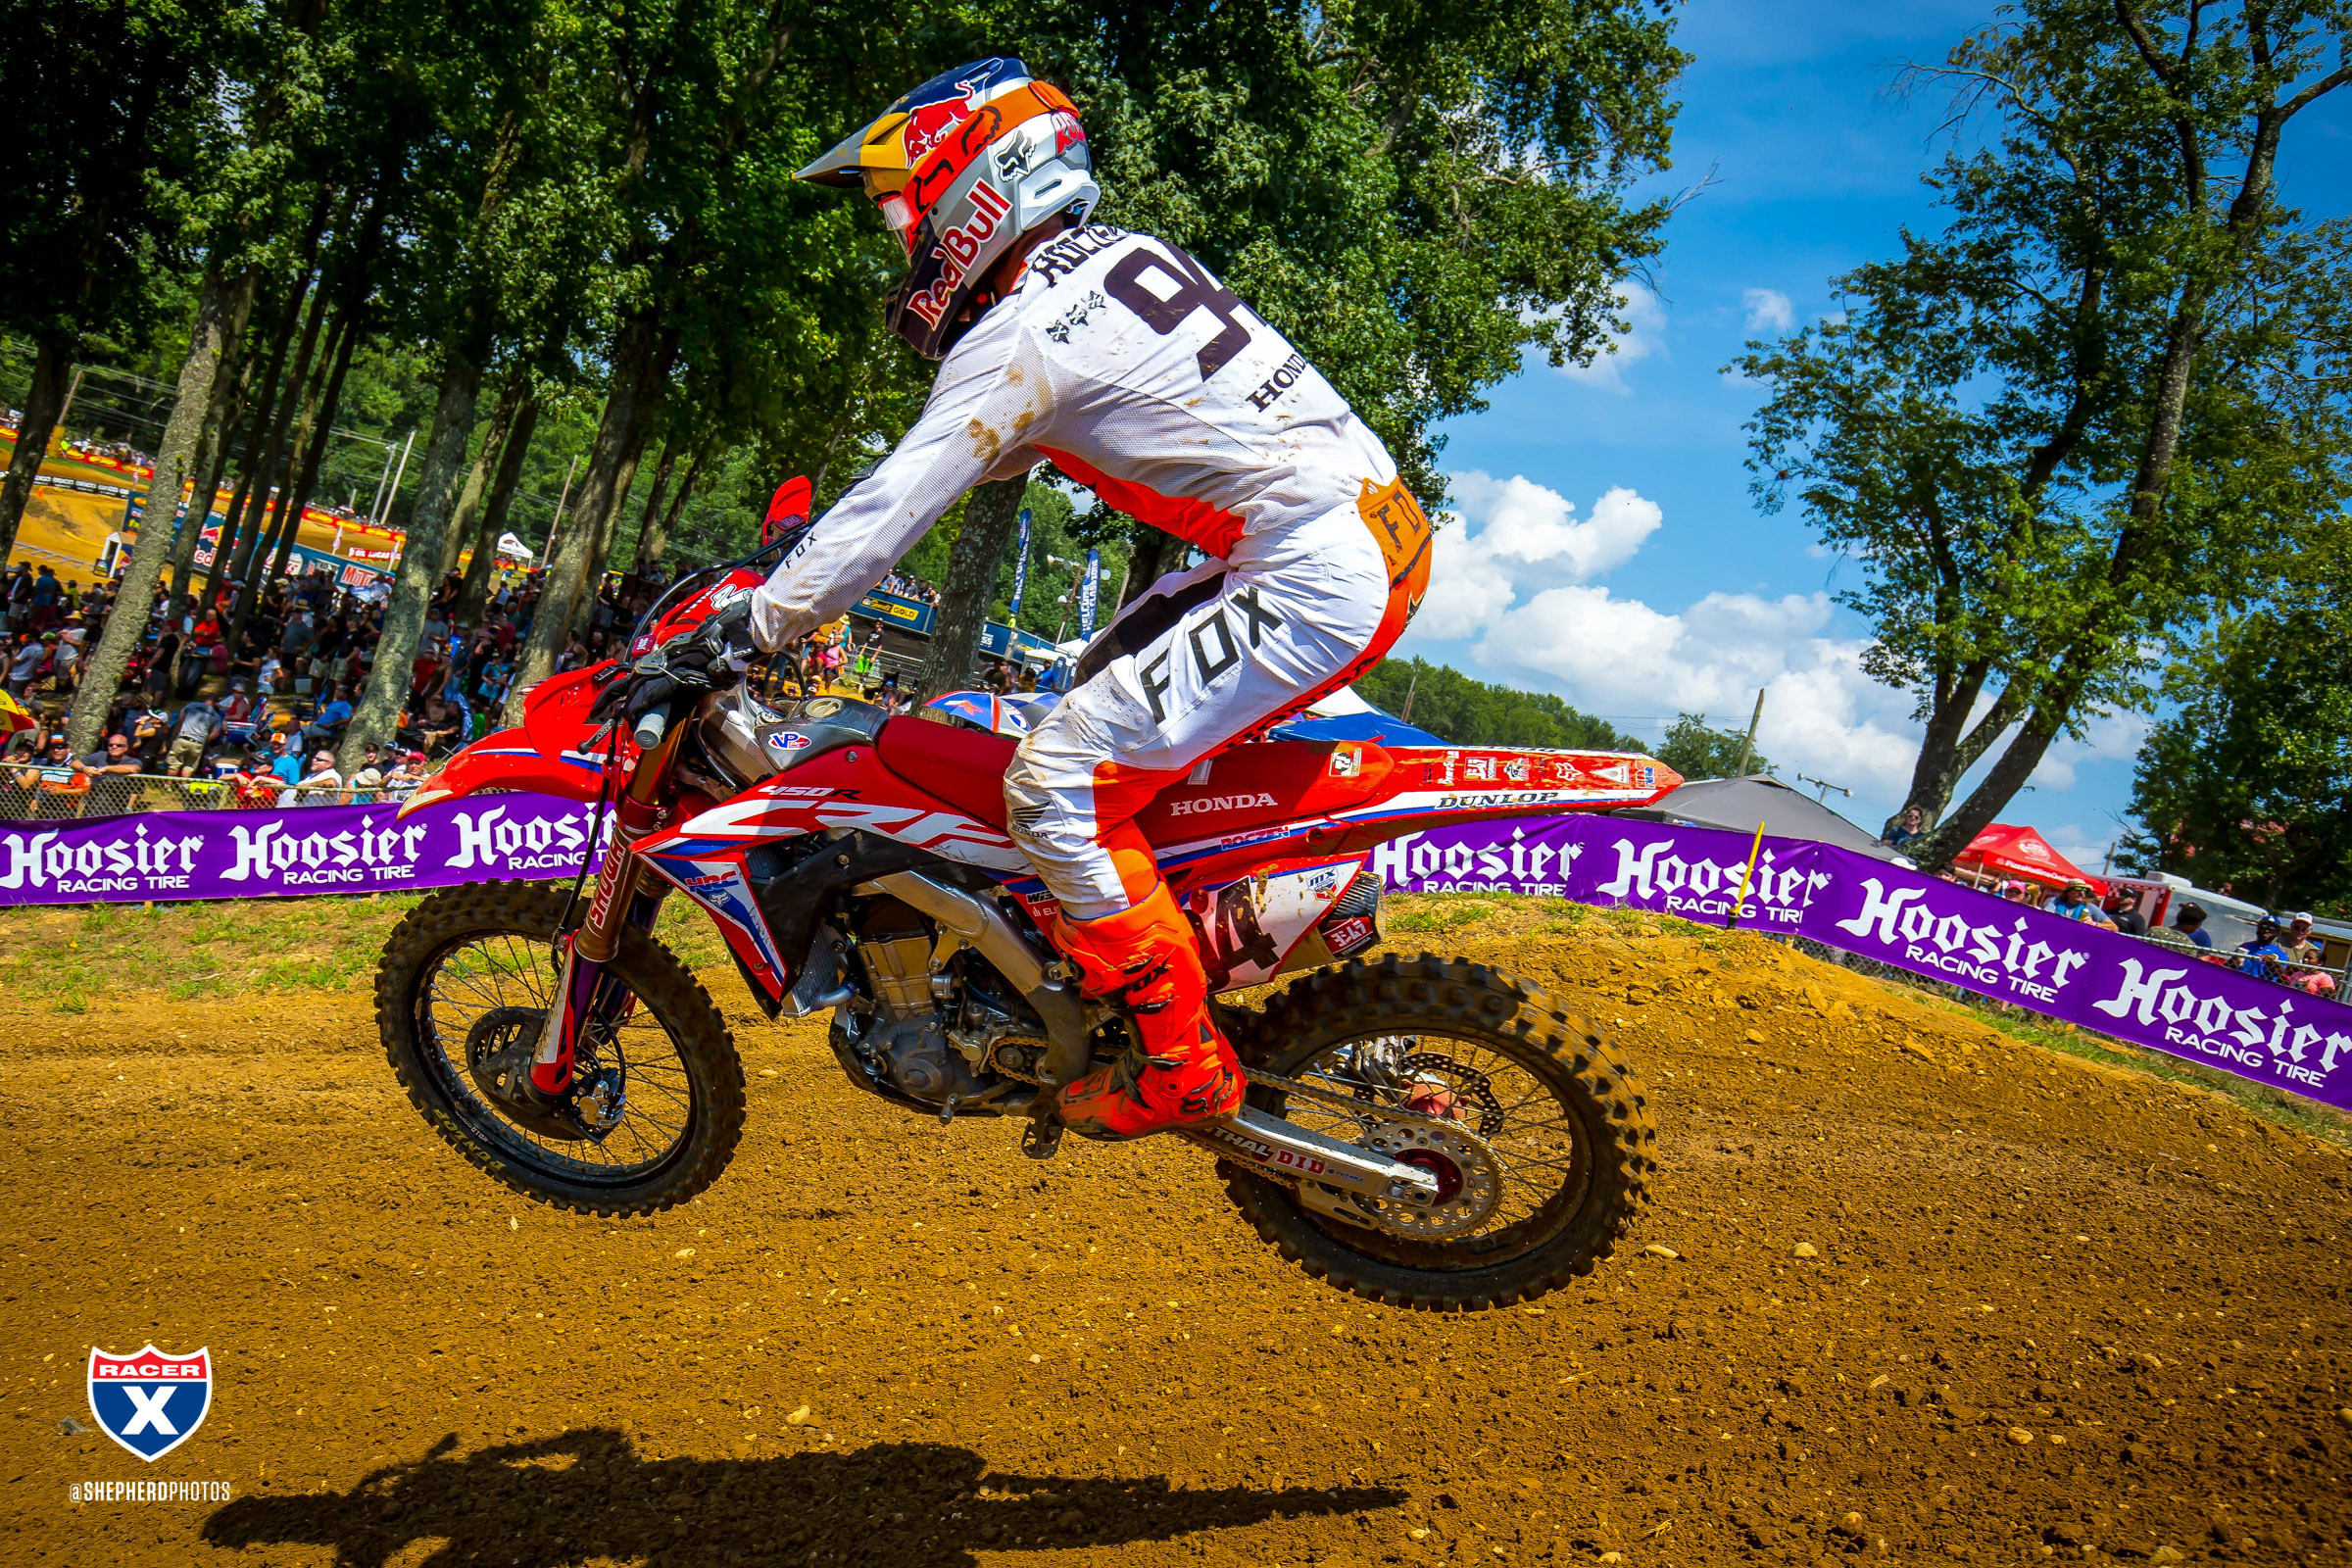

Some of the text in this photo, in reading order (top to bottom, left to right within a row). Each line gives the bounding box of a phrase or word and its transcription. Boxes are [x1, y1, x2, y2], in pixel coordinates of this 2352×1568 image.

[906, 176, 1014, 331] Red Bull
[1246, 354, 1309, 413] HOND
[785, 531, 817, 568] FOX
[893, 607, 915, 618] GOLD
[1140, 586, 1282, 724] FOX
[771, 733, 799, 749] VP
[758, 785, 863, 801] 450R
[1170, 792, 1279, 816] HONDA
[1436, 792, 1558, 809] DUNLOP
[219, 813, 427, 881] Hoosier
[444, 802, 618, 869] Hoosi
[680, 799, 1016, 849] CRF
[1010, 824, 1050, 840] HONDA
[0, 822, 205, 890] Hoosier
[282, 864, 416, 885] RACING TIRE
[508, 852, 588, 870] RACING
[686, 870, 739, 893] HRC
[1373, 825, 1584, 888] Hoosier
[1594, 838, 1831, 907] Hoosier
[57, 875, 190, 893] RACING TIRE
[589, 840, 627, 929] SHOWA
[1423, 880, 1567, 898] RACING TIRE
[1835, 877, 2086, 989] Hoosier
[1905, 944, 2058, 1004] RACING TIRE
[2091, 957, 2352, 1073] Hoosier
[2164, 1026, 2328, 1088] RACING TIRE
